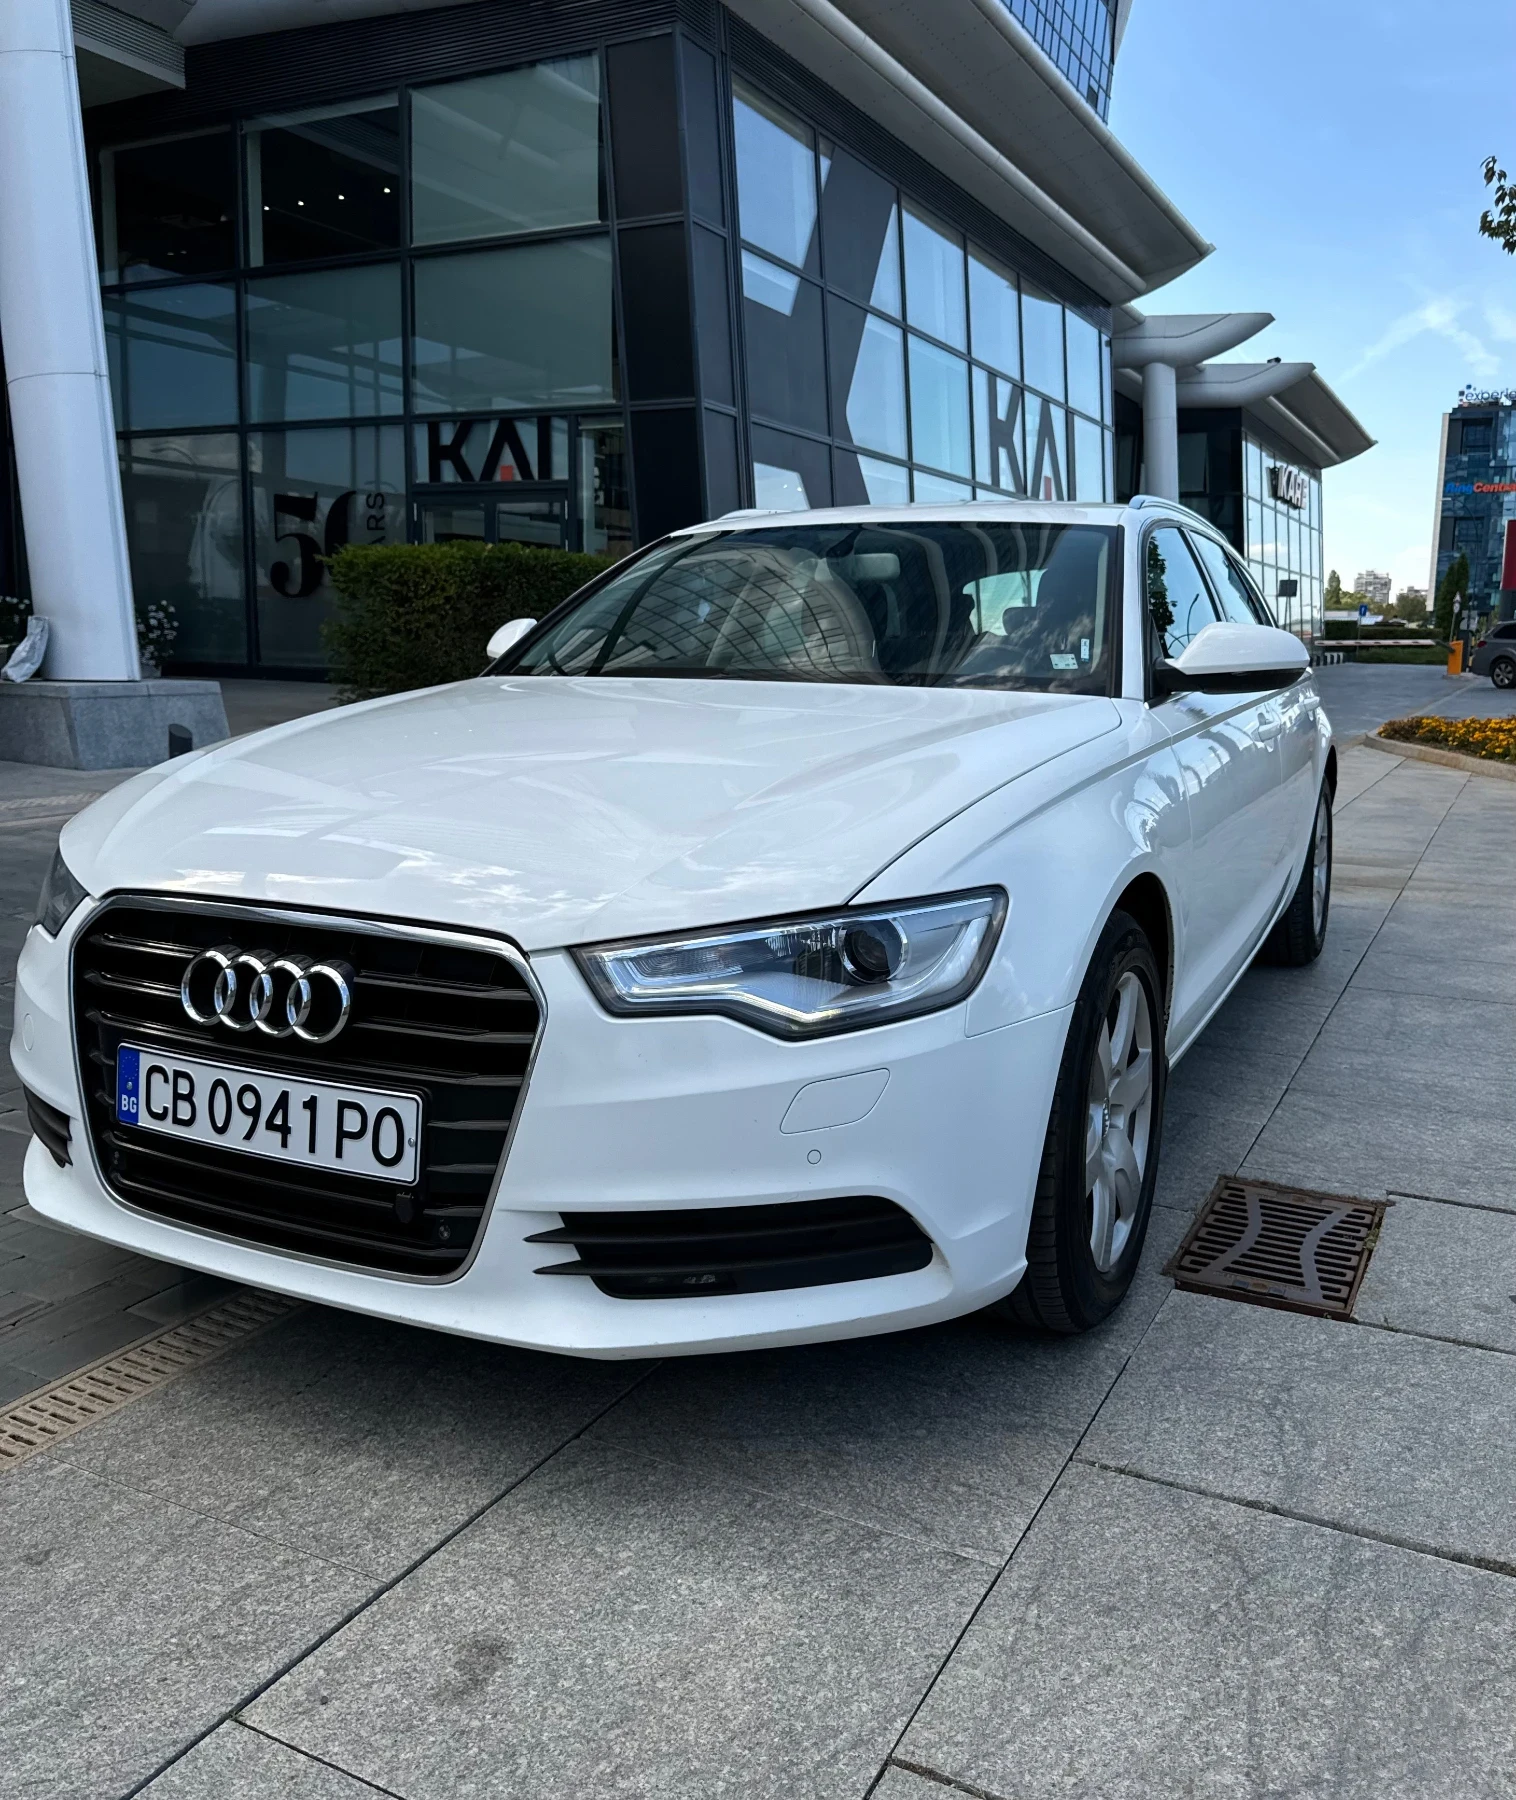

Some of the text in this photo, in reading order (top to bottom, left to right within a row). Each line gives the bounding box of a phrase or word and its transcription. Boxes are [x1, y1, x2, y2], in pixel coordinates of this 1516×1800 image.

[428, 416, 551, 483] KAI
[121, 1094, 137, 1114] BG
[145, 1064, 404, 1167] CB 0941 PO
